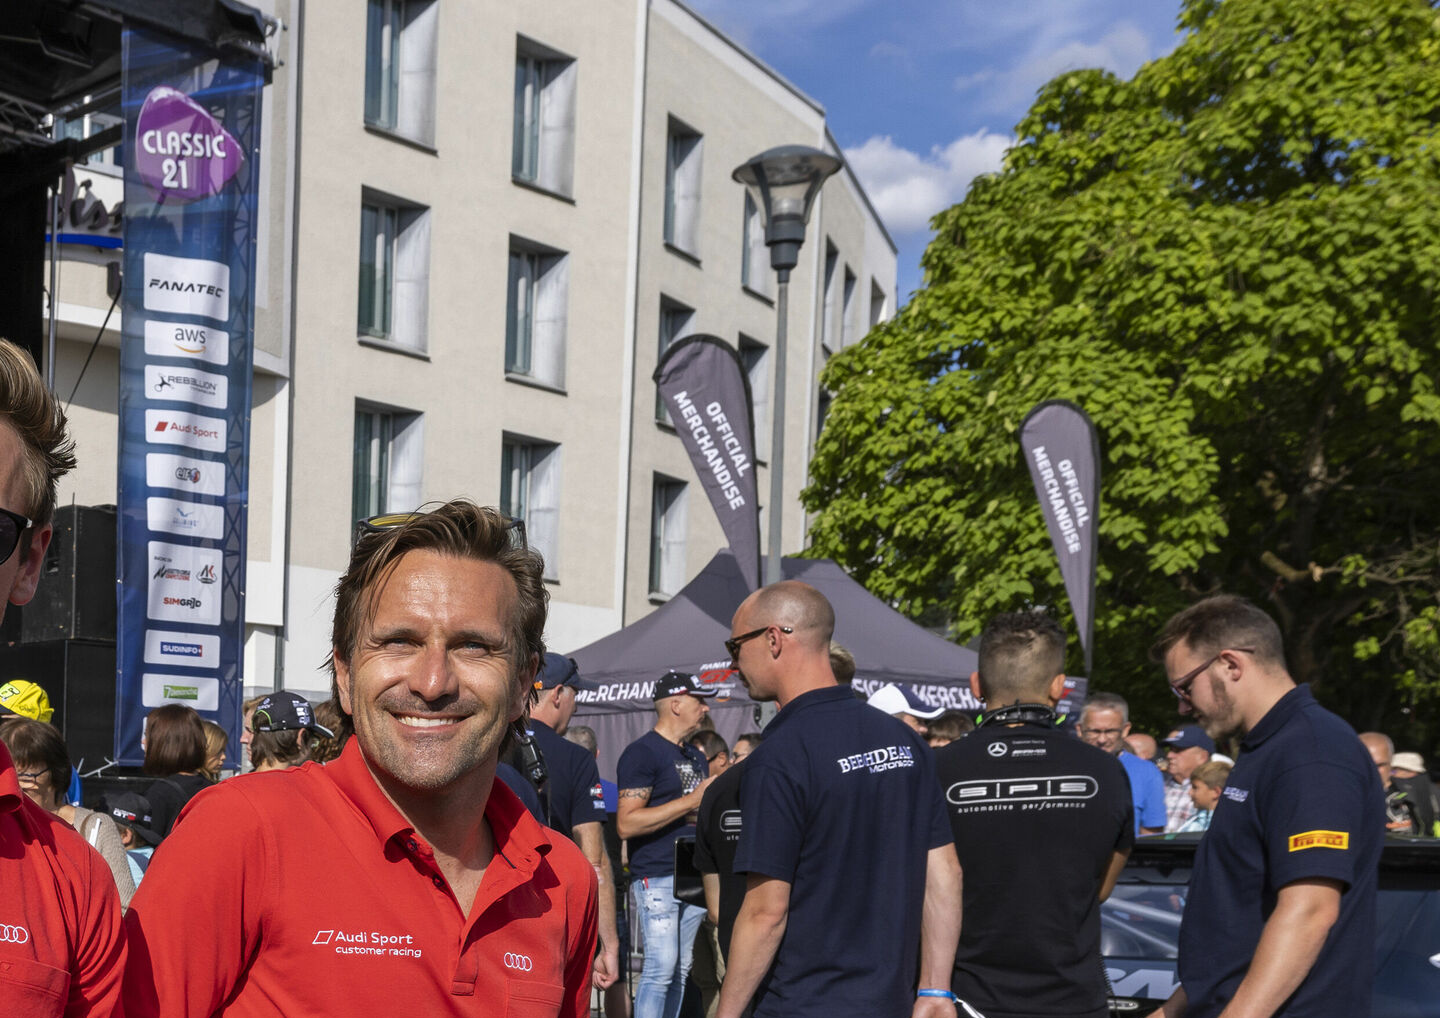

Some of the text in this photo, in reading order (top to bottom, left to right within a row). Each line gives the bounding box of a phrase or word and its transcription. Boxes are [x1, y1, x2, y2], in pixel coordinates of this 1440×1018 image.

[143, 130, 226, 158] CLASSIC
[162, 158, 188, 188] 21
[149, 278, 223, 298] FANATEC
[175, 328, 207, 345] aws
[170, 422, 218, 439] Audi Sport
[706, 401, 751, 478] OFFICIAL
[673, 390, 746, 511] MERCHANDISE
[1032, 445, 1082, 555] MERCHANDISE
[1058, 459, 1090, 528] OFFICIAL
[574, 680, 657, 703] MERCHAN
[958, 801, 1086, 814] automotive performance
[1293, 834, 1343, 848] PIRELLI
[335, 931, 413, 947] Audi Sport
[335, 945, 422, 958] customer racing
